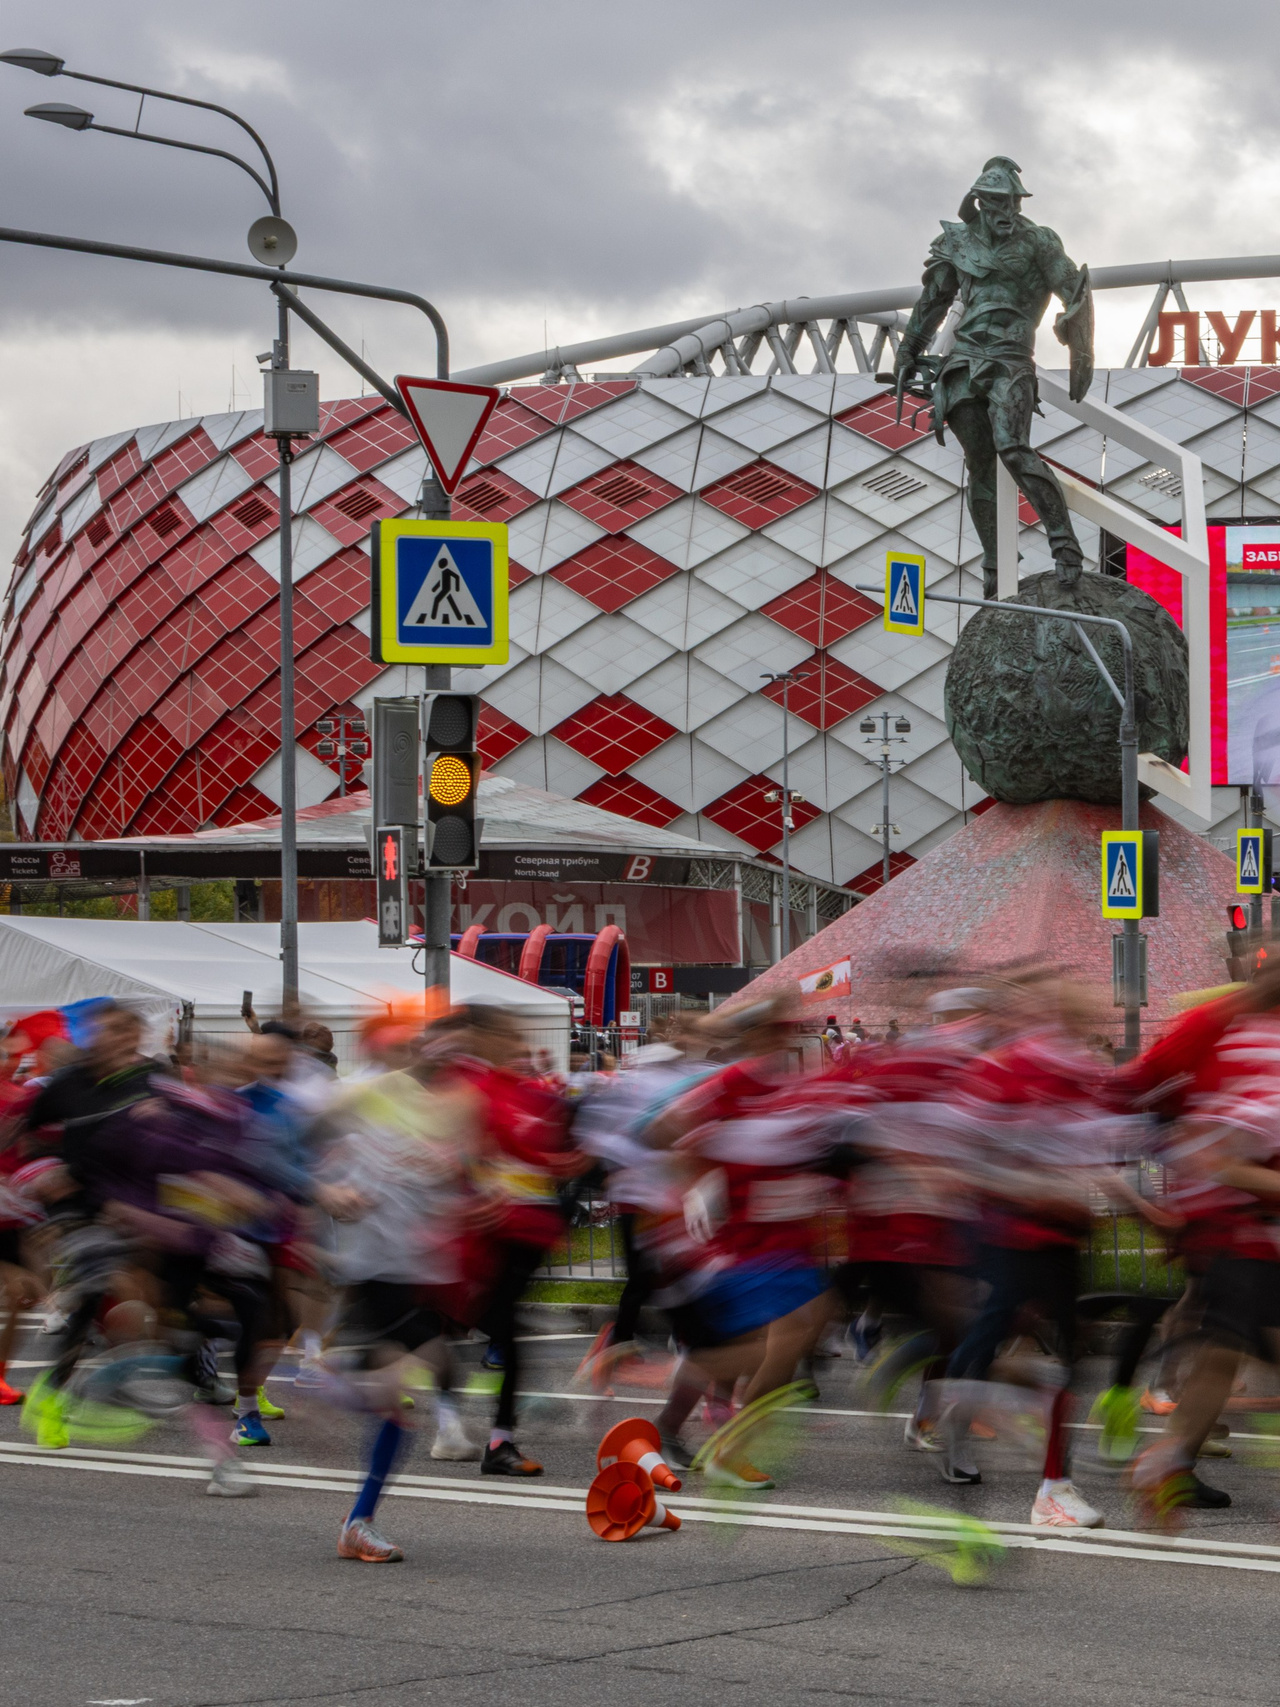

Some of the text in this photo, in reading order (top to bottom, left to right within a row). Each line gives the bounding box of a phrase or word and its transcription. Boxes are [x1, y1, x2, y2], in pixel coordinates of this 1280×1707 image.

[11, 856, 40, 864] Кассы
[514, 855, 599, 867] Северная трибуна
[627, 855, 651, 880] B
[538, 870, 559, 878] Stand
